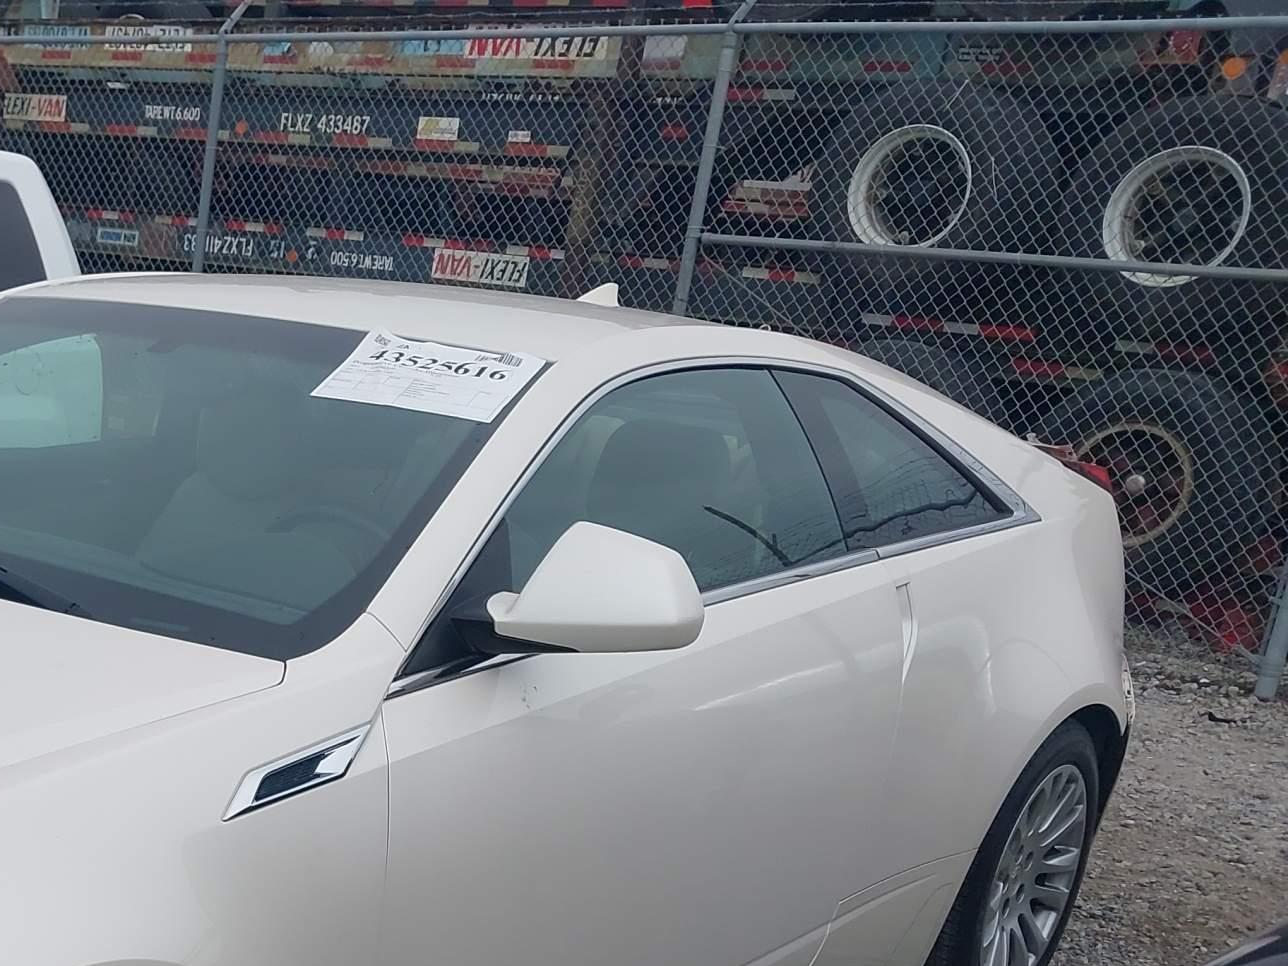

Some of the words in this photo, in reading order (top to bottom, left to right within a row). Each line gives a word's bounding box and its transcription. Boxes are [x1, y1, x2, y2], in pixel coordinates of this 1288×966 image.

[280, 112, 313, 132] FLXZ
[317, 114, 370, 135] 433487
[434, 253, 527, 283] FLEXI-VAN
[368, 348, 511, 382] 43525616
